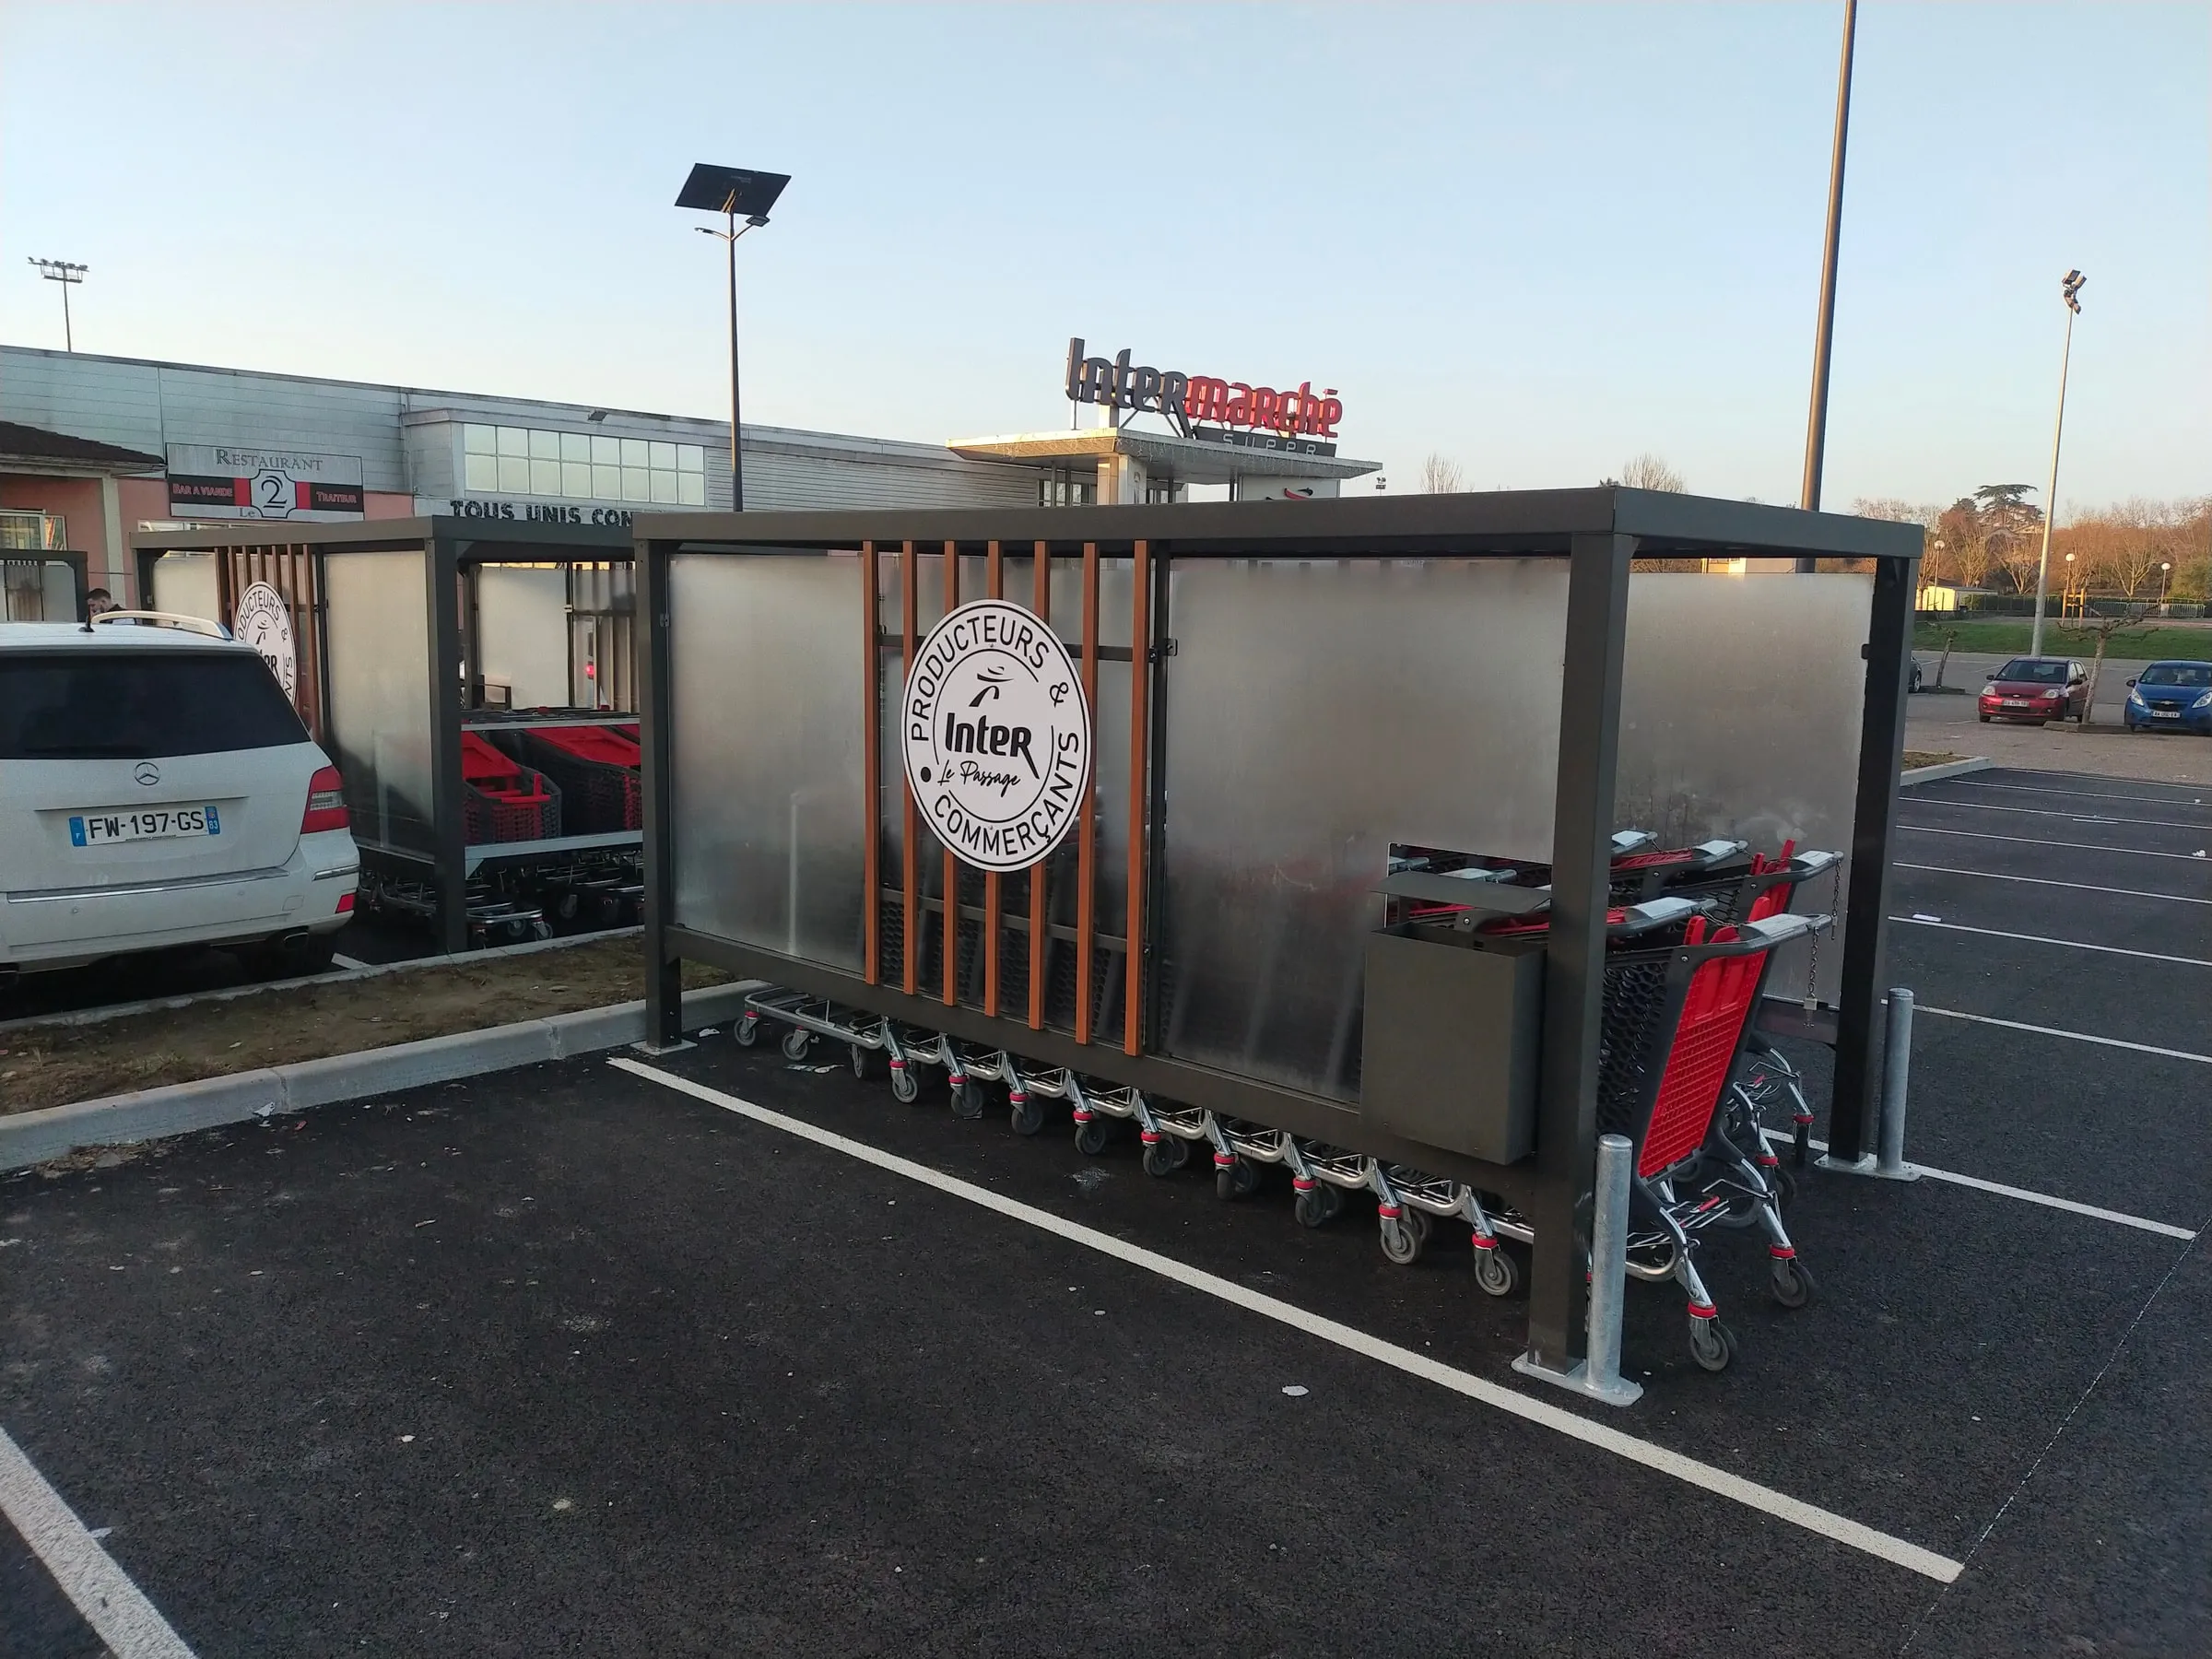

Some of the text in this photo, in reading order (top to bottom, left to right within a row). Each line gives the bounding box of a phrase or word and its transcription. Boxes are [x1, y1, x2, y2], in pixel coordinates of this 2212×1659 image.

[172, 484, 193, 495] BAR
[239, 475, 288, 518] Le 2
[315, 491, 358, 504] TRAITEUR
[450, 500, 515, 520] TOUS
[526, 504, 582, 524] UNIS
[237, 590, 281, 641] ODUCTEURS
[912, 615, 1069, 741] PRODUCTEURS &
[934, 732, 1079, 856] COMMERÇANTS
[937, 759, 1022, 798] Le Passage
[88, 811, 205, 840] FW-197-GS
